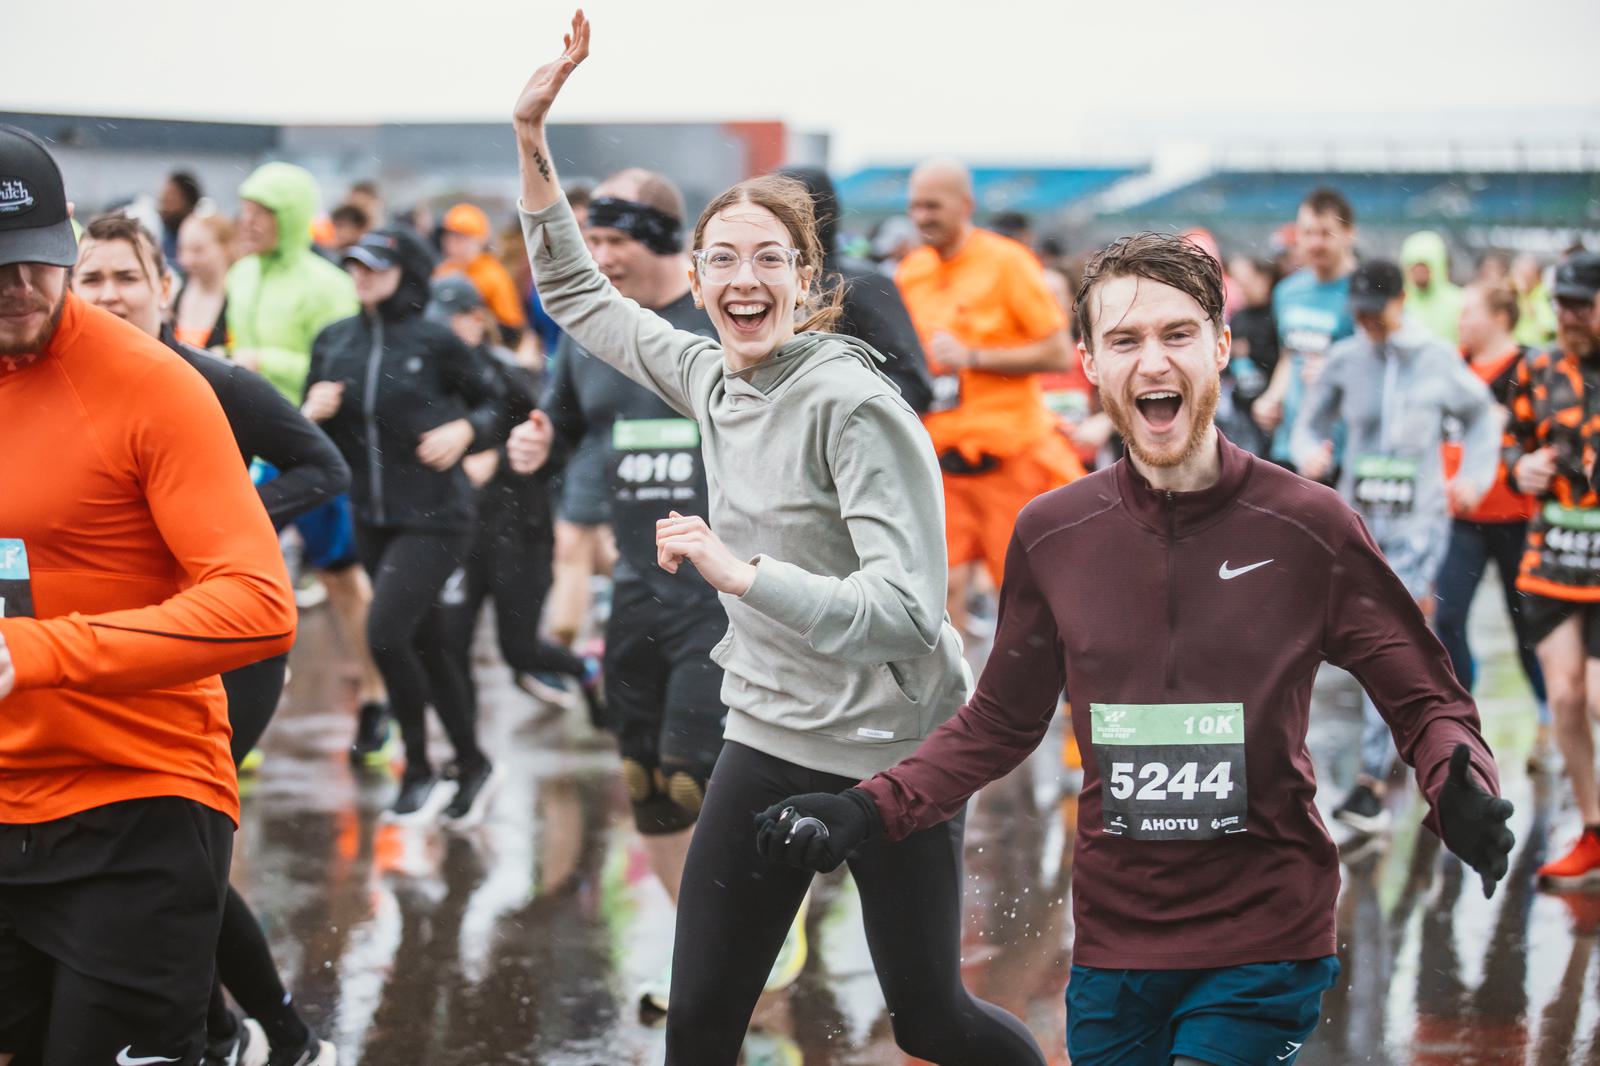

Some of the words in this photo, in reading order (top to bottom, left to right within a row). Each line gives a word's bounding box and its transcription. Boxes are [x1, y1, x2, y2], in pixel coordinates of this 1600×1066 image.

[0, 181, 28, 200] utch
[1184, 715, 1234, 735] 10K
[1110, 762, 1234, 800] 5244
[1141, 818, 1198, 831] AHOTU
